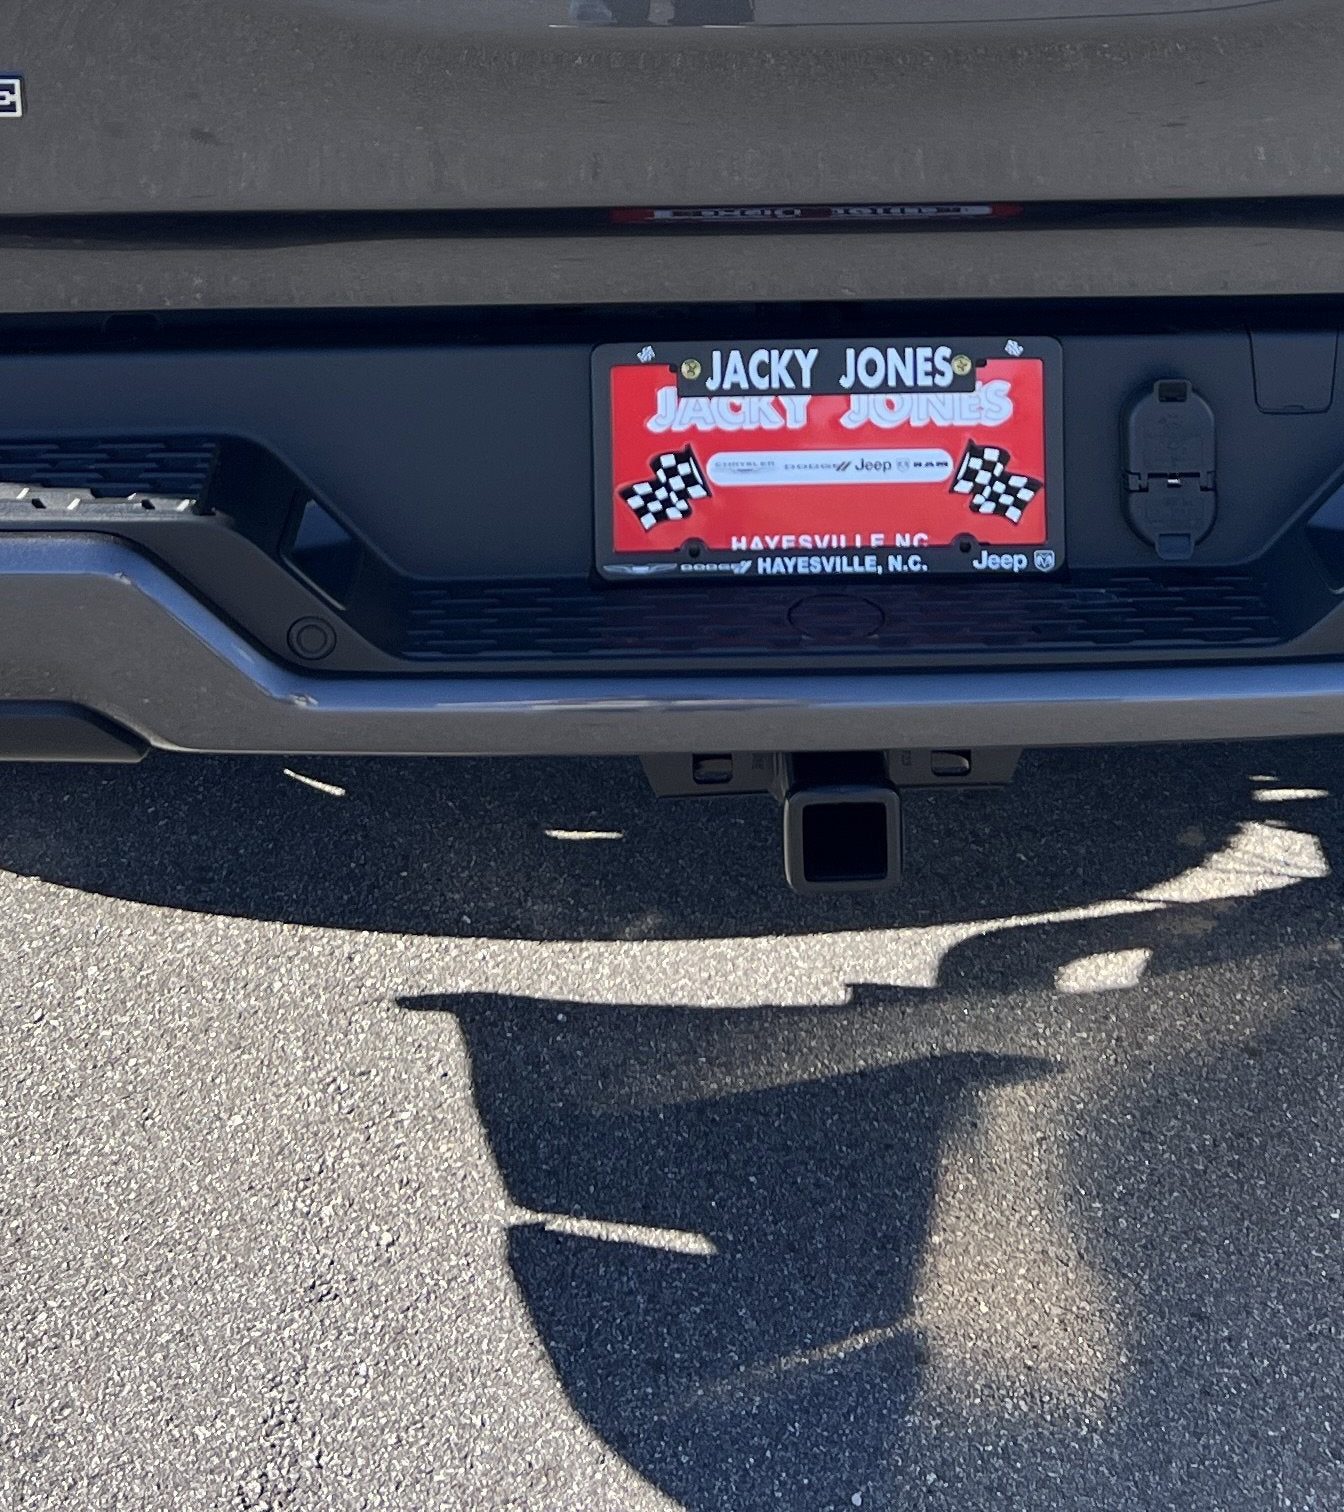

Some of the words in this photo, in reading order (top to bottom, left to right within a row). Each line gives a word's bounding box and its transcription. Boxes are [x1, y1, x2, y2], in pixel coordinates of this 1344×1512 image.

[705, 348, 819, 391] JACKY
[838, 346, 955, 389] JONES
[646, 385, 812, 433] JACKY
[839, 378, 1014, 429] JONES
[854, 457, 892, 473] Jeep
[757, 554, 884, 575] HAYESVILLE,
[887, 554, 928, 572] N.C.
[972, 550, 1028, 573] Jeep
